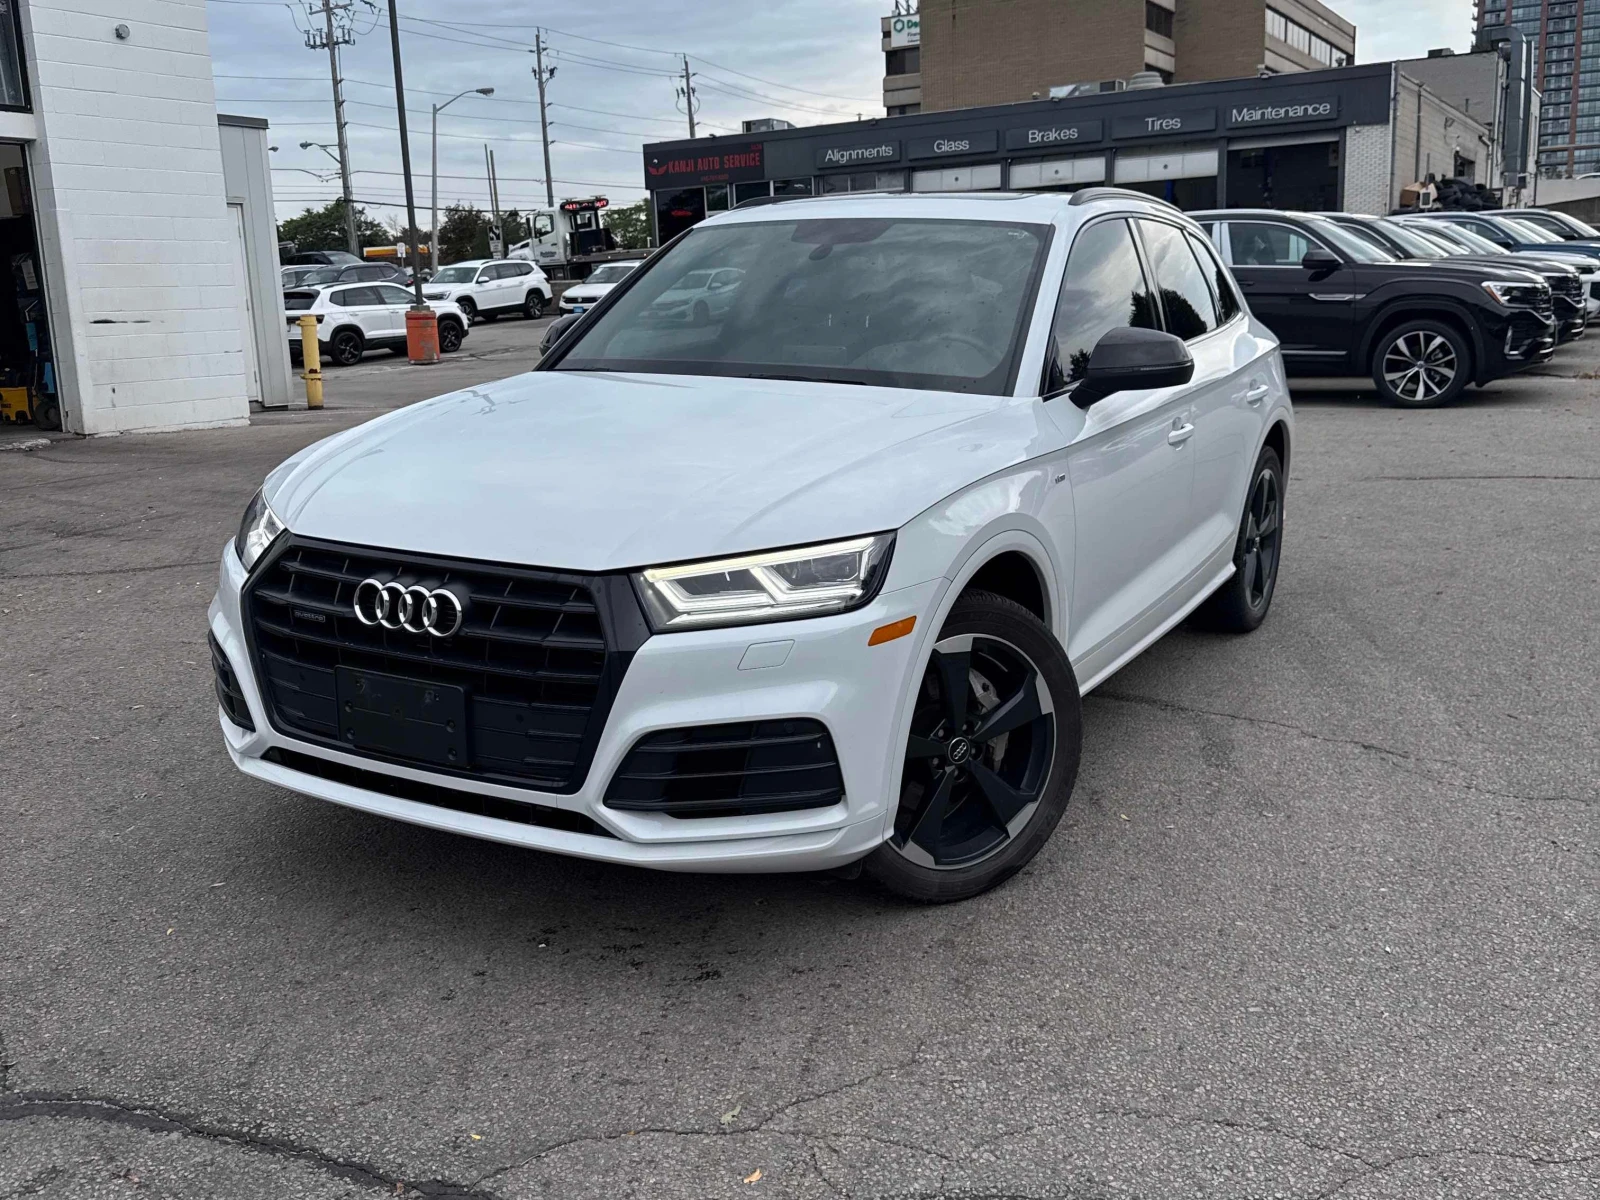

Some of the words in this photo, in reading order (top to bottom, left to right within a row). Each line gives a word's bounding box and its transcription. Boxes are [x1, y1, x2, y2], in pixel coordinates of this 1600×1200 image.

[1232, 103, 1331, 122] Maintenance
[1145, 117, 1181, 131] Tires
[1028, 128, 1078, 143] Brakes
[825, 144, 893, 163] Alignments
[933, 139, 969, 153] Glass
[668, 160, 694, 174] KANJI
[697, 157, 720, 171] AUTO
[723, 152, 760, 169] SERVICE
